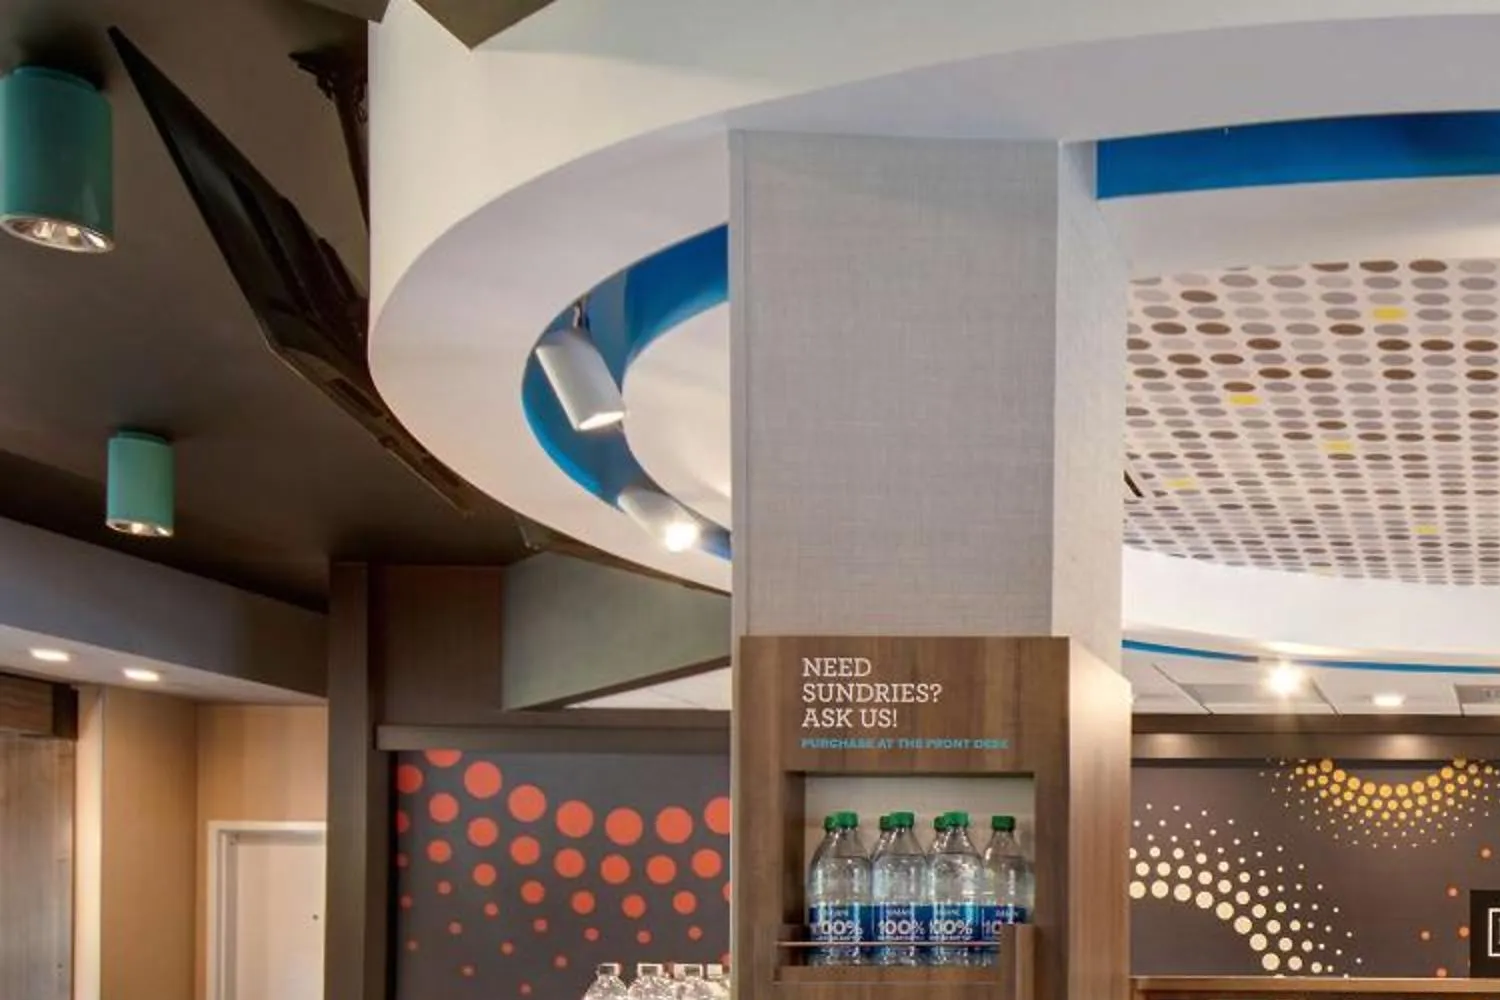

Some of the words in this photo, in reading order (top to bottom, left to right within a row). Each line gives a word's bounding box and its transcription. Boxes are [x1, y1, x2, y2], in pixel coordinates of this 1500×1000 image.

[802, 657, 872, 677] NEED
[802, 683, 943, 703] SUNDRIES?
[801, 707, 854, 728] ASK
[860, 707, 898, 728] US!
[801, 737, 872, 749] PURCHASE
[877, 737, 895, 749] AT
[898, 737, 923, 749] THE
[926, 737, 970, 749] FRONT
[974, 737, 1008, 749] DESK
[878, 919, 925, 936] 100%
